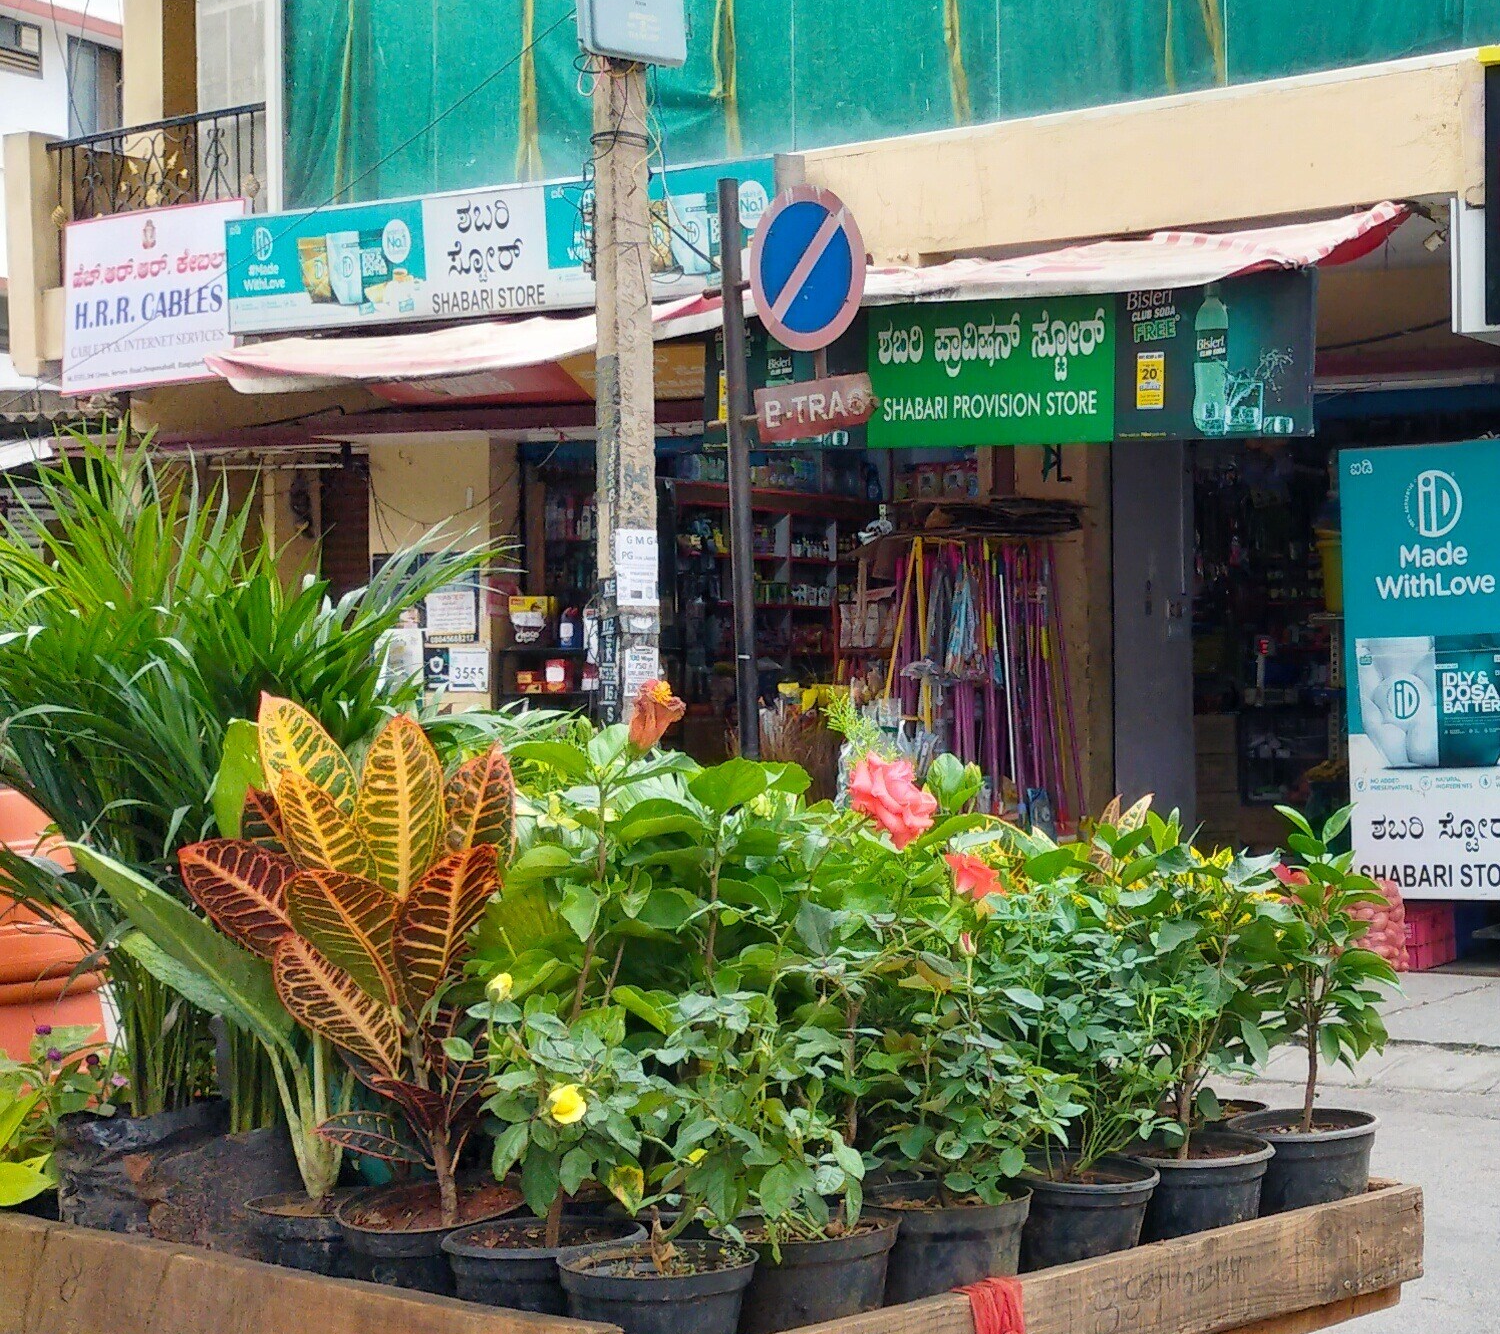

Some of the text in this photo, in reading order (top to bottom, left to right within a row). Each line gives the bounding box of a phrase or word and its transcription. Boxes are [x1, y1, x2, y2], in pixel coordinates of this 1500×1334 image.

[456, 199, 511, 234] ಶಬರಿ
[447, 238, 524, 283] ಸ್ಟೋರ್
[75, 295, 135, 330] H.R.R.
[140, 284, 224, 321] CABLES
[432, 284, 547, 315] SHABARI STORE
[1126, 289, 1173, 311] Bisleri
[1131, 305, 1177, 323] CLUB SODA
[124, 333, 174, 352] INTERNET
[175, 328, 225, 345] SERVICES
[1132, 317, 1178, 344] FREE
[1196, 335, 1225, 351] Bisleri
[878, 320, 924, 364] ಶಬರಿ
[1031, 307, 1106, 382] ಸ್ಟೋರ್
[883, 390, 1098, 421] SHABARI PROVISION STORE
[1400, 540, 1469, 568] Made
[1375, 572, 1496, 600] WithLove
[1441, 670, 1490, 688] IDLY &
[1442, 683, 1500, 701] DOSA
[1371, 814, 1425, 841] ಶಬರಿ
[1360, 864, 1454, 889] SHABARI
